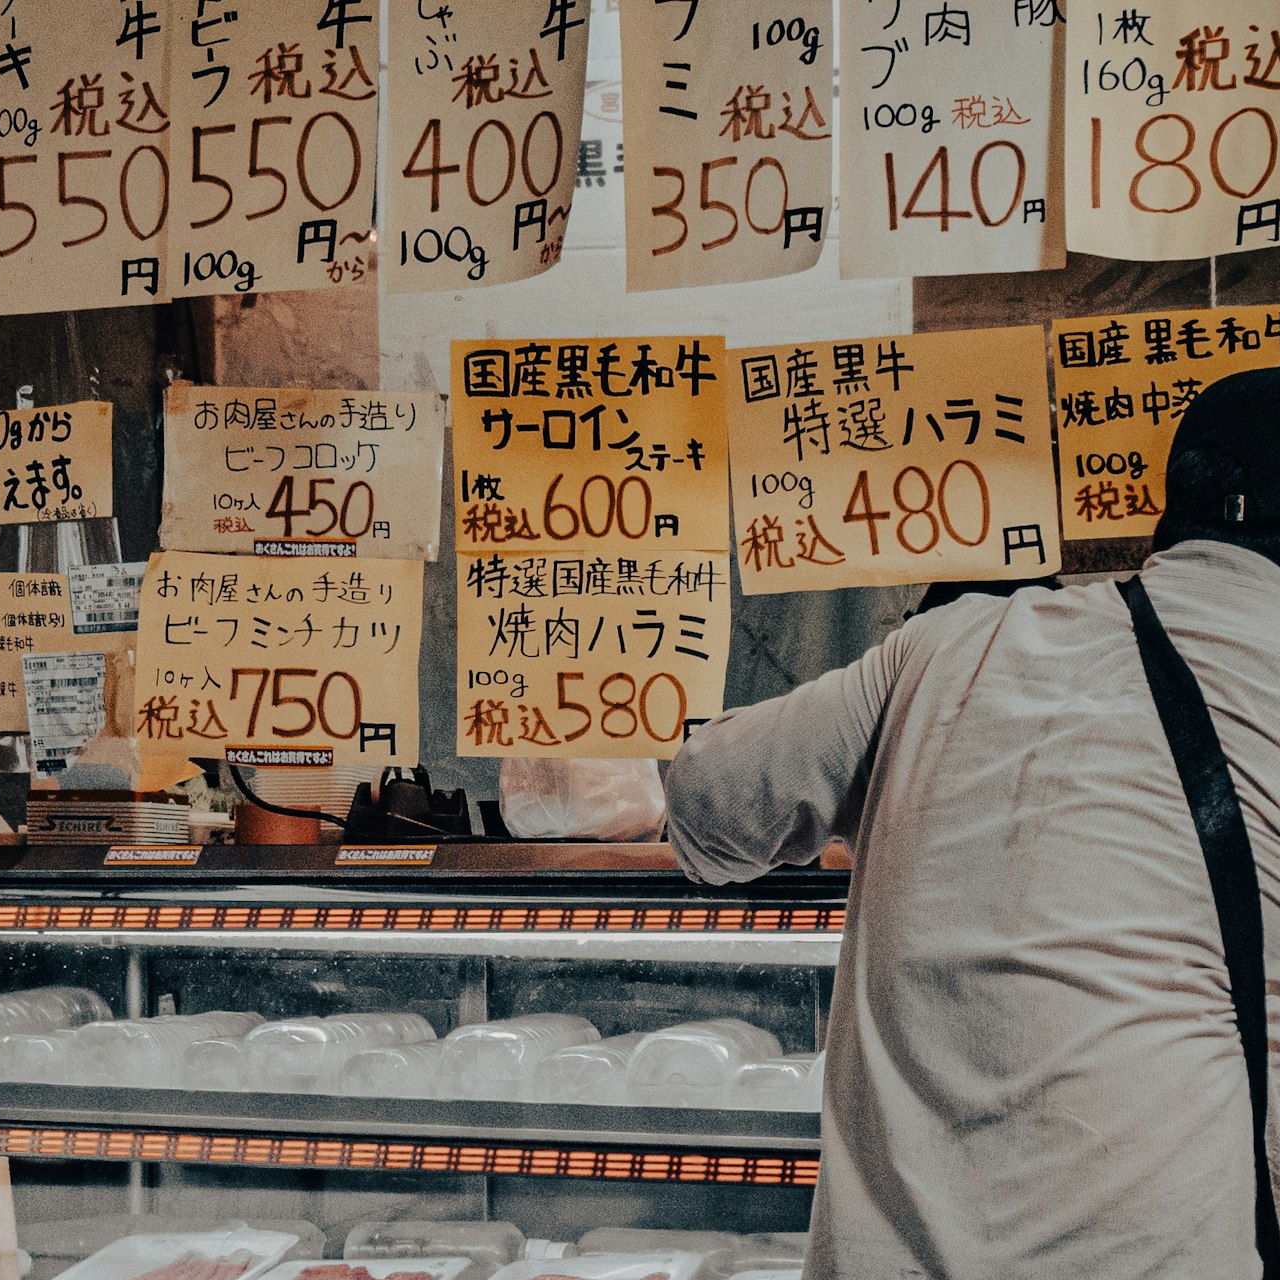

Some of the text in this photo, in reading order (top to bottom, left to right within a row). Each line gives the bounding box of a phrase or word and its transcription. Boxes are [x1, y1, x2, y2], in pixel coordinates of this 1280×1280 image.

[116, 0, 162, 60] 牛
[752, 17, 824, 65] 100g
[923, 1, 971, 47] 肉
[1096, 8, 1154, 46] 1枚
[248, 41, 377, 104] 税込
[451, 47, 554, 110] 税込
[1083, 57, 1170, 107] 160g
[50, 70, 171, 137] 税込
[719, 84, 832, 143] 税込
[862, 95, 1032, 134] 100g 税込
[184, 249, 263, 292] 100g
[326, 256, 365, 283] から
[400, 226, 489, 281] 100g
[463, 340, 718, 400] 国産黒毛和牛
[741, 339, 915, 404] 国産黒牛
[194, 397, 417, 432] お肉屋さんの手造り
[782, 392, 1027, 462] 特選ハラミ
[224, 440, 380, 473] ビーフコロッケ
[1074, 452, 1149, 478] 100g
[461, 469, 506, 503] 1枚
[750, 471, 816, 510] 100g
[1074, 482, 1164, 523] 税込
[213, 516, 256, 534] 税込
[462, 503, 541, 544] 税込
[740, 512, 847, 573] 税込
[156, 570, 393, 607] お肉屋さんの手造り
[466, 552, 727, 603] 特選国産黒毛和牛
[164, 613, 402, 655] ビーフミンチカツ
[488, 601, 711, 661] 焼肉ハラミ
[467, 668, 529, 698] 100g
[137, 694, 228, 740] 税込
[463, 698, 561, 748] 税込
